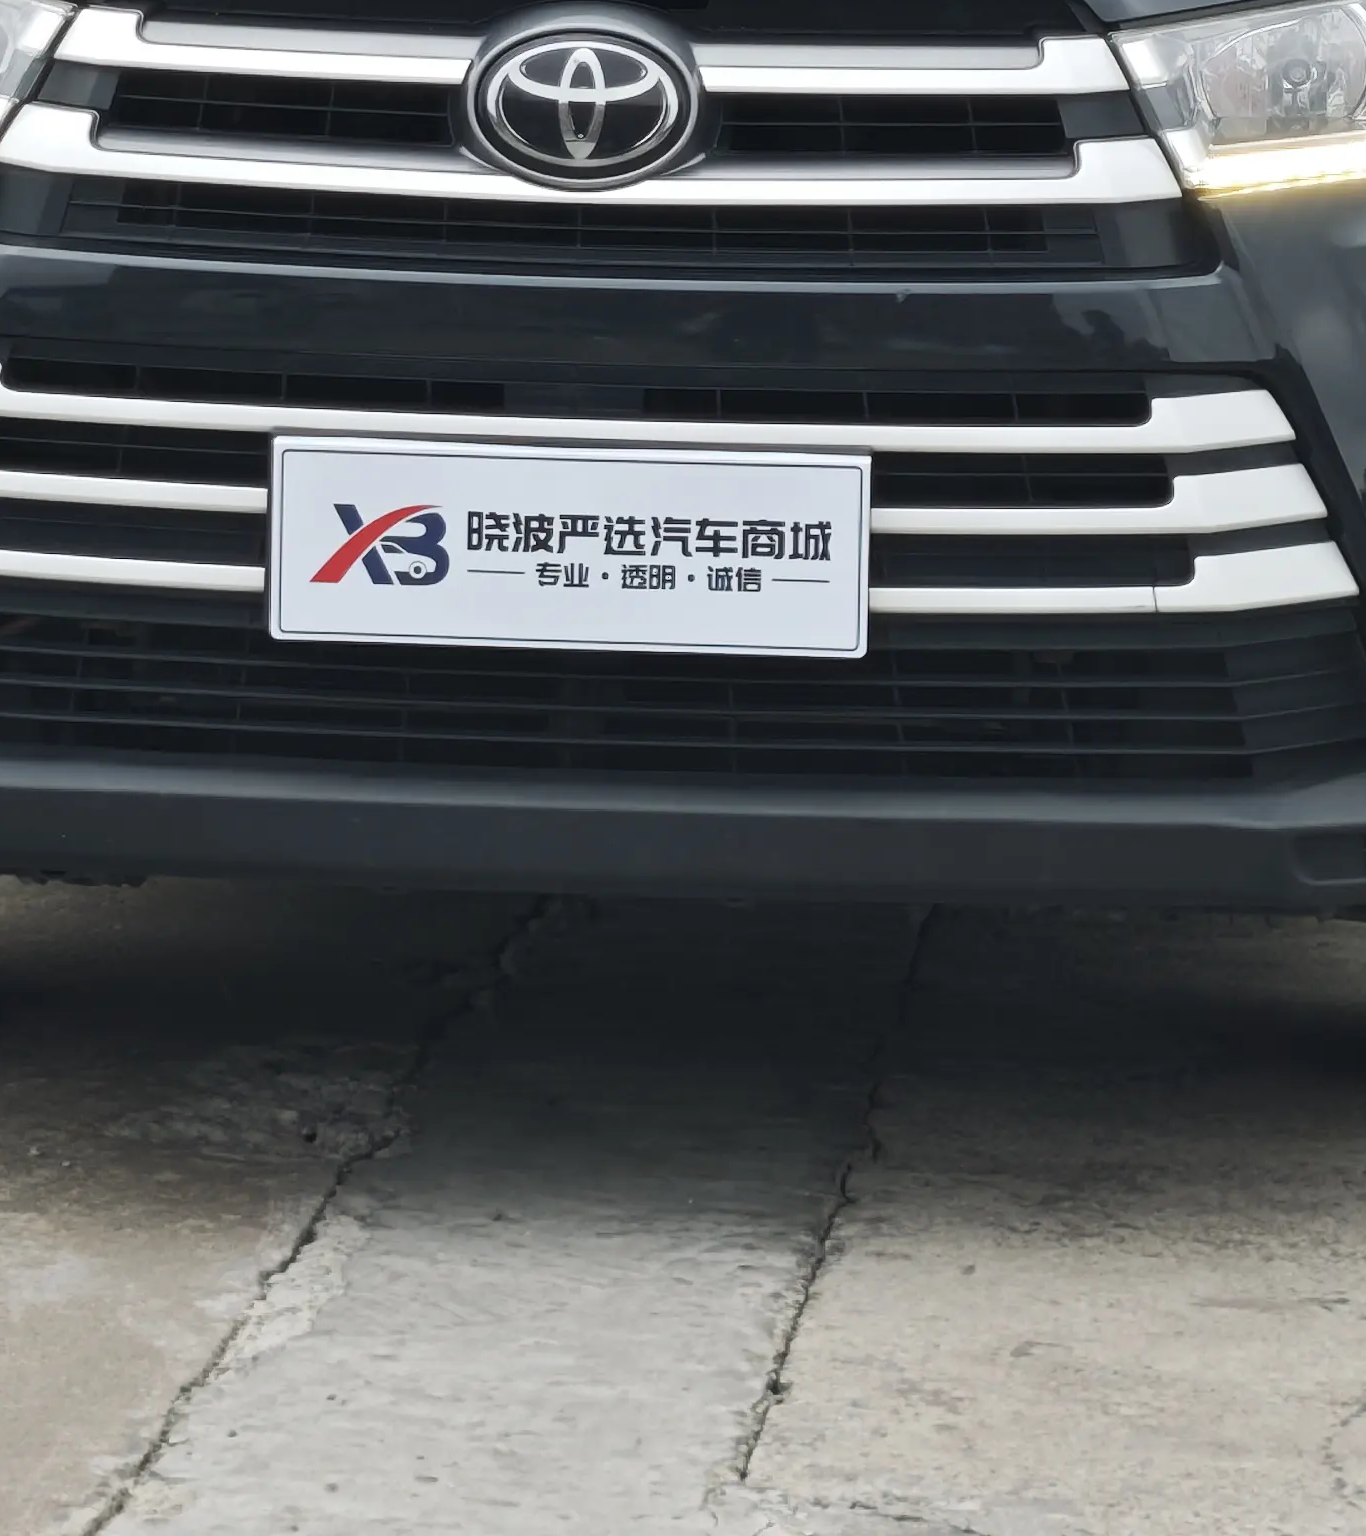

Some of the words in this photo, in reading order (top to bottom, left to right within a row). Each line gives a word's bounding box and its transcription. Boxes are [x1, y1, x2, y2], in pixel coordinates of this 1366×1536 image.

[466, 510, 832, 561] 晓波严选汽车商城
